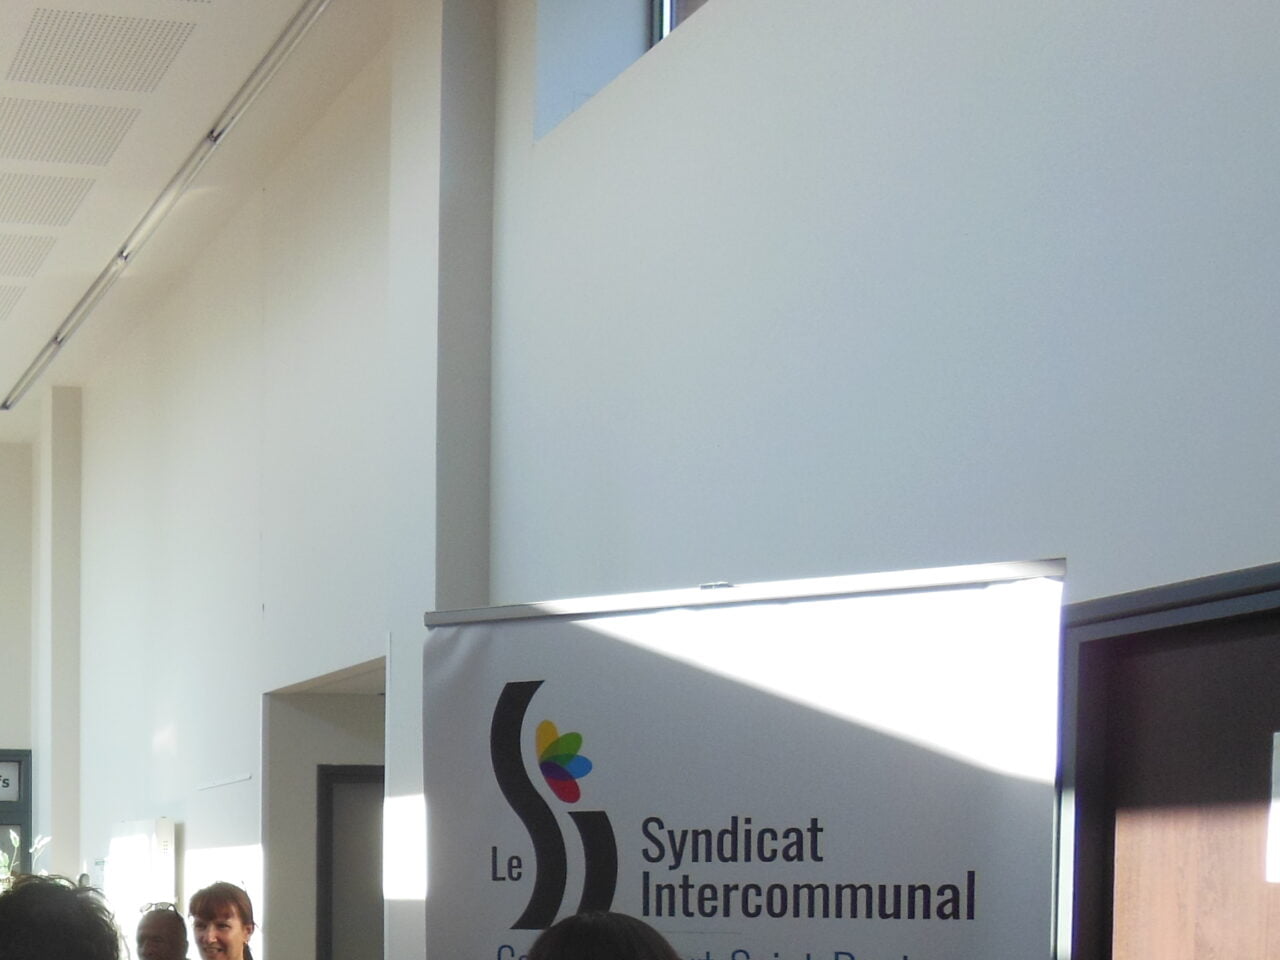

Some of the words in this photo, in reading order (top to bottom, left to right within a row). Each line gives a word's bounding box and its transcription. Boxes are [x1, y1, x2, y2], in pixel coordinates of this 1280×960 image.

[491, 846, 523, 882] Le
[641, 816, 824, 870] Syndicat
[642, 870, 975, 921] Intercommunal
